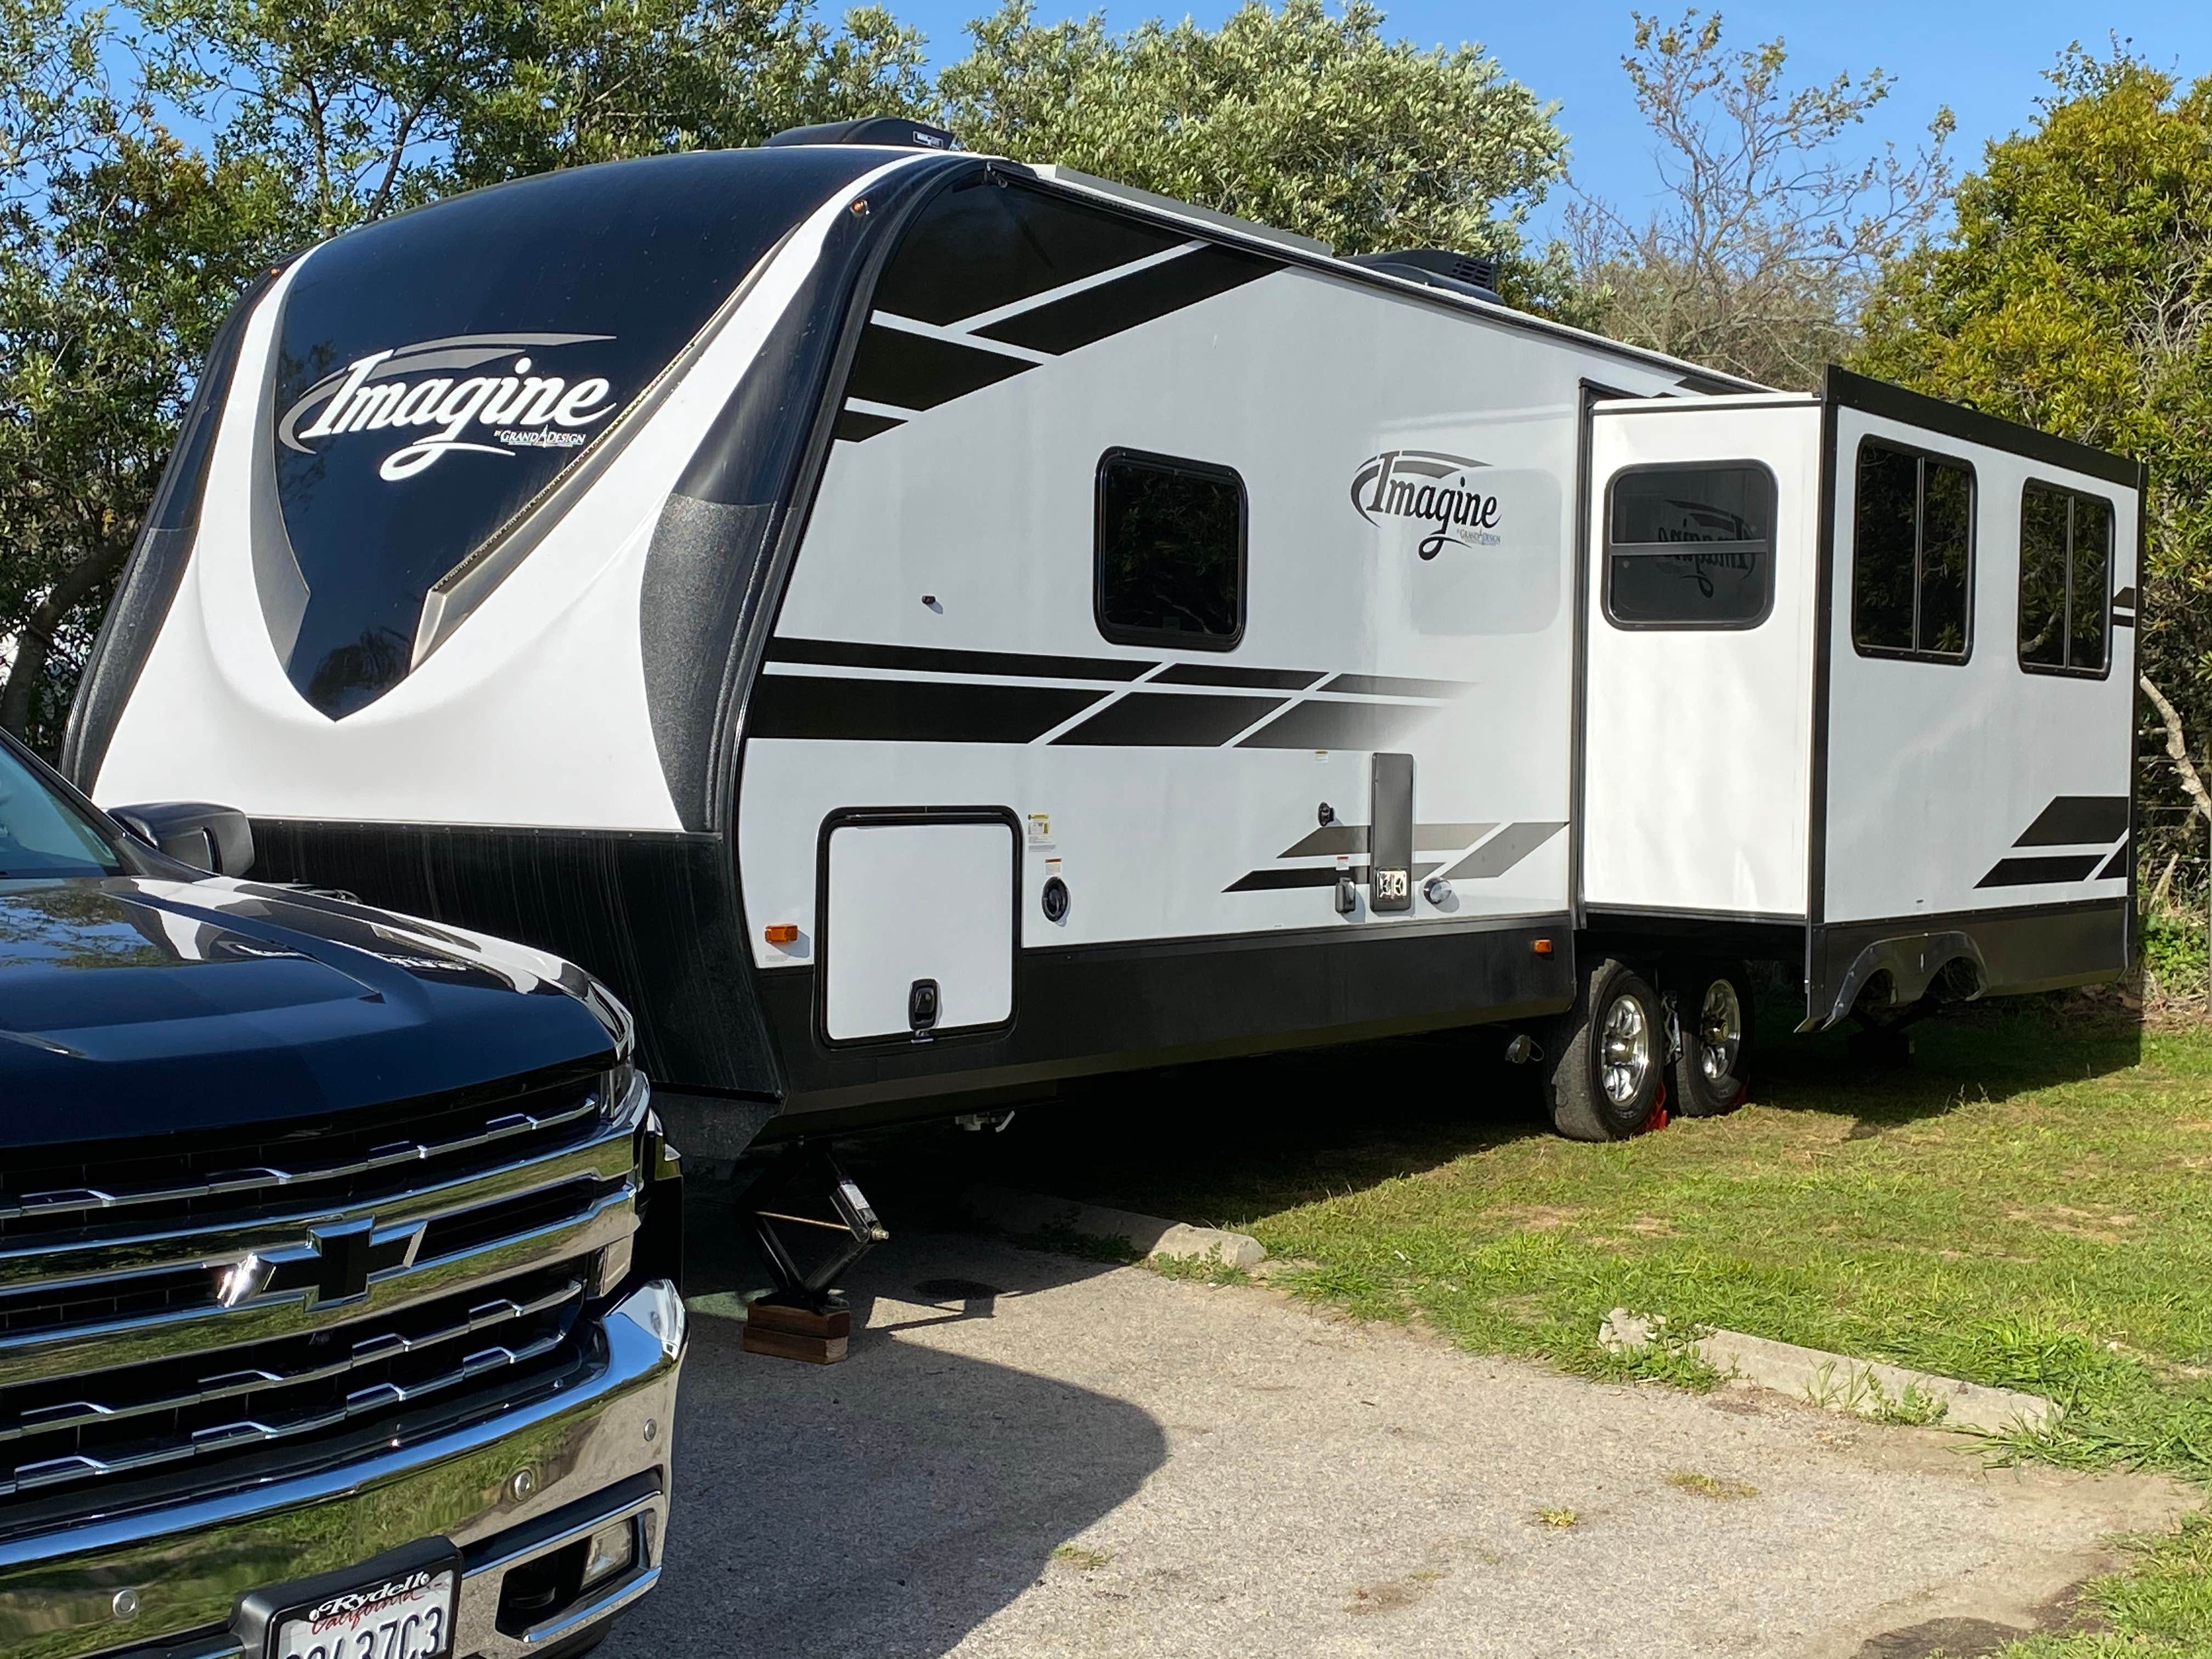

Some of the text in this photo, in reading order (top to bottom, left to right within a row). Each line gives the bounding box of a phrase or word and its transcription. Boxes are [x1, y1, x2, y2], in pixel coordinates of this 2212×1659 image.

[298, 348, 617, 481] Imagine
[500, 430, 538, 443] GRAND
[548, 431, 586, 445] DESIGN
[1365, 450, 1502, 561] Imagine
[319, 1571, 424, 1616] Rydell
[285, 1606, 442, 1659] 37C3
